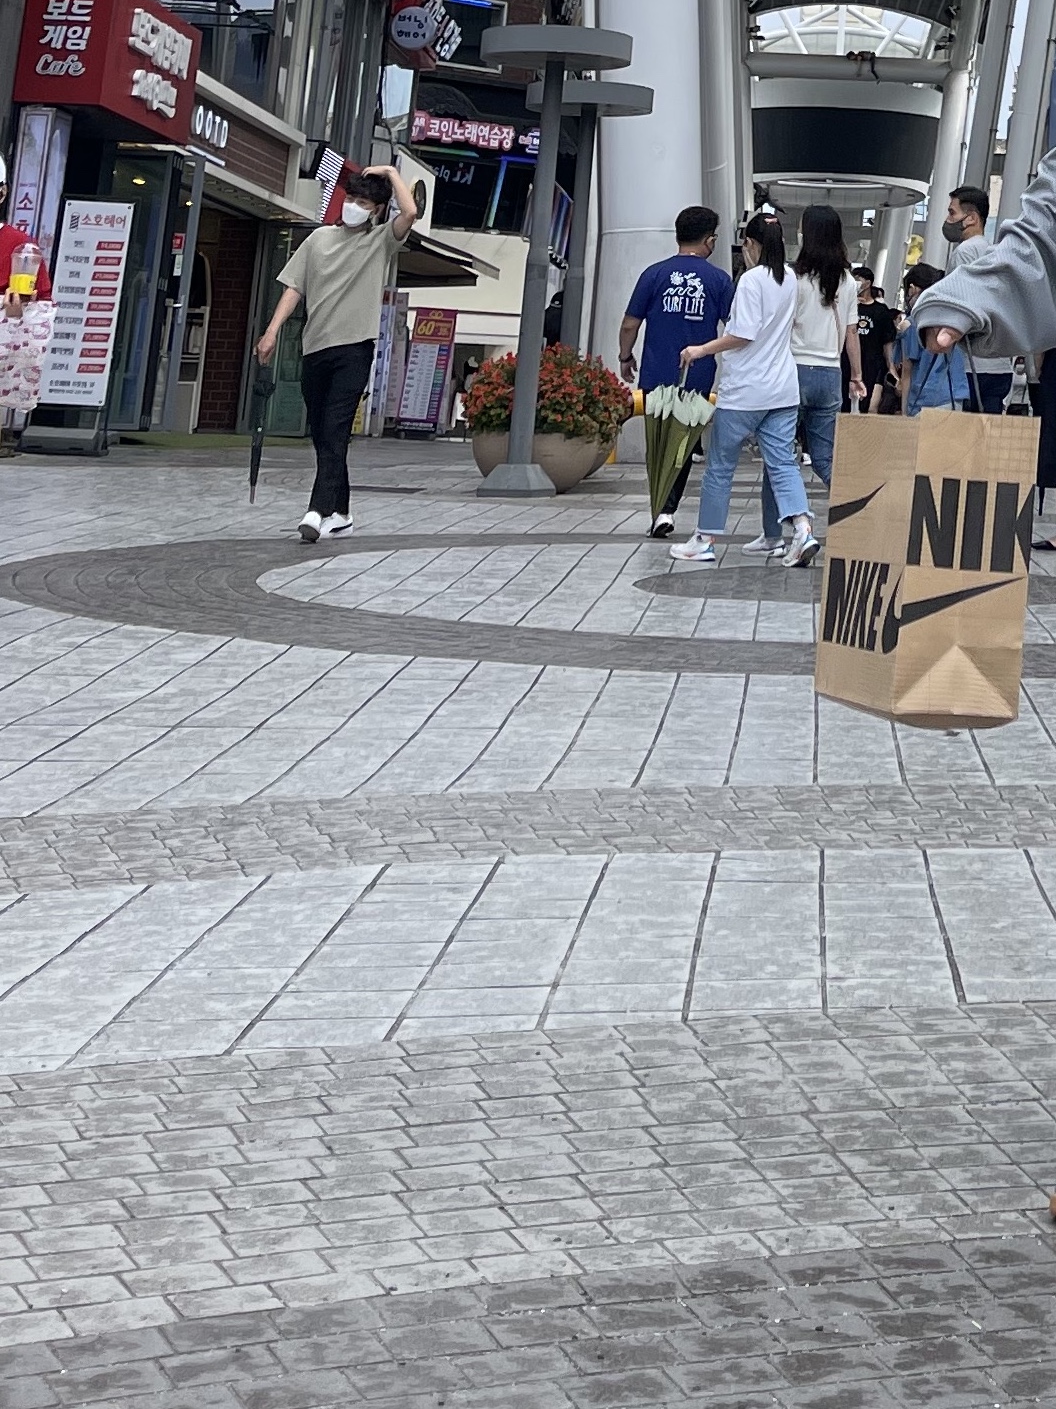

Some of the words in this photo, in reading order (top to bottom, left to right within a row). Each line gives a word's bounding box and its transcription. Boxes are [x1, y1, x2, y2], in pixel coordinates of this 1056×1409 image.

[39, 25, 91, 51] 게임
[36, 53, 86, 78] Cafe
[194, 104, 230, 149] OOTD
[427, 118, 515, 150] 코인노래연습장
[81, 213, 127, 229] 소호헤어
[662, 295, 684, 314] SURF
[684, 295, 706, 316] LIFE
[823, 558, 890, 652] NIKE
